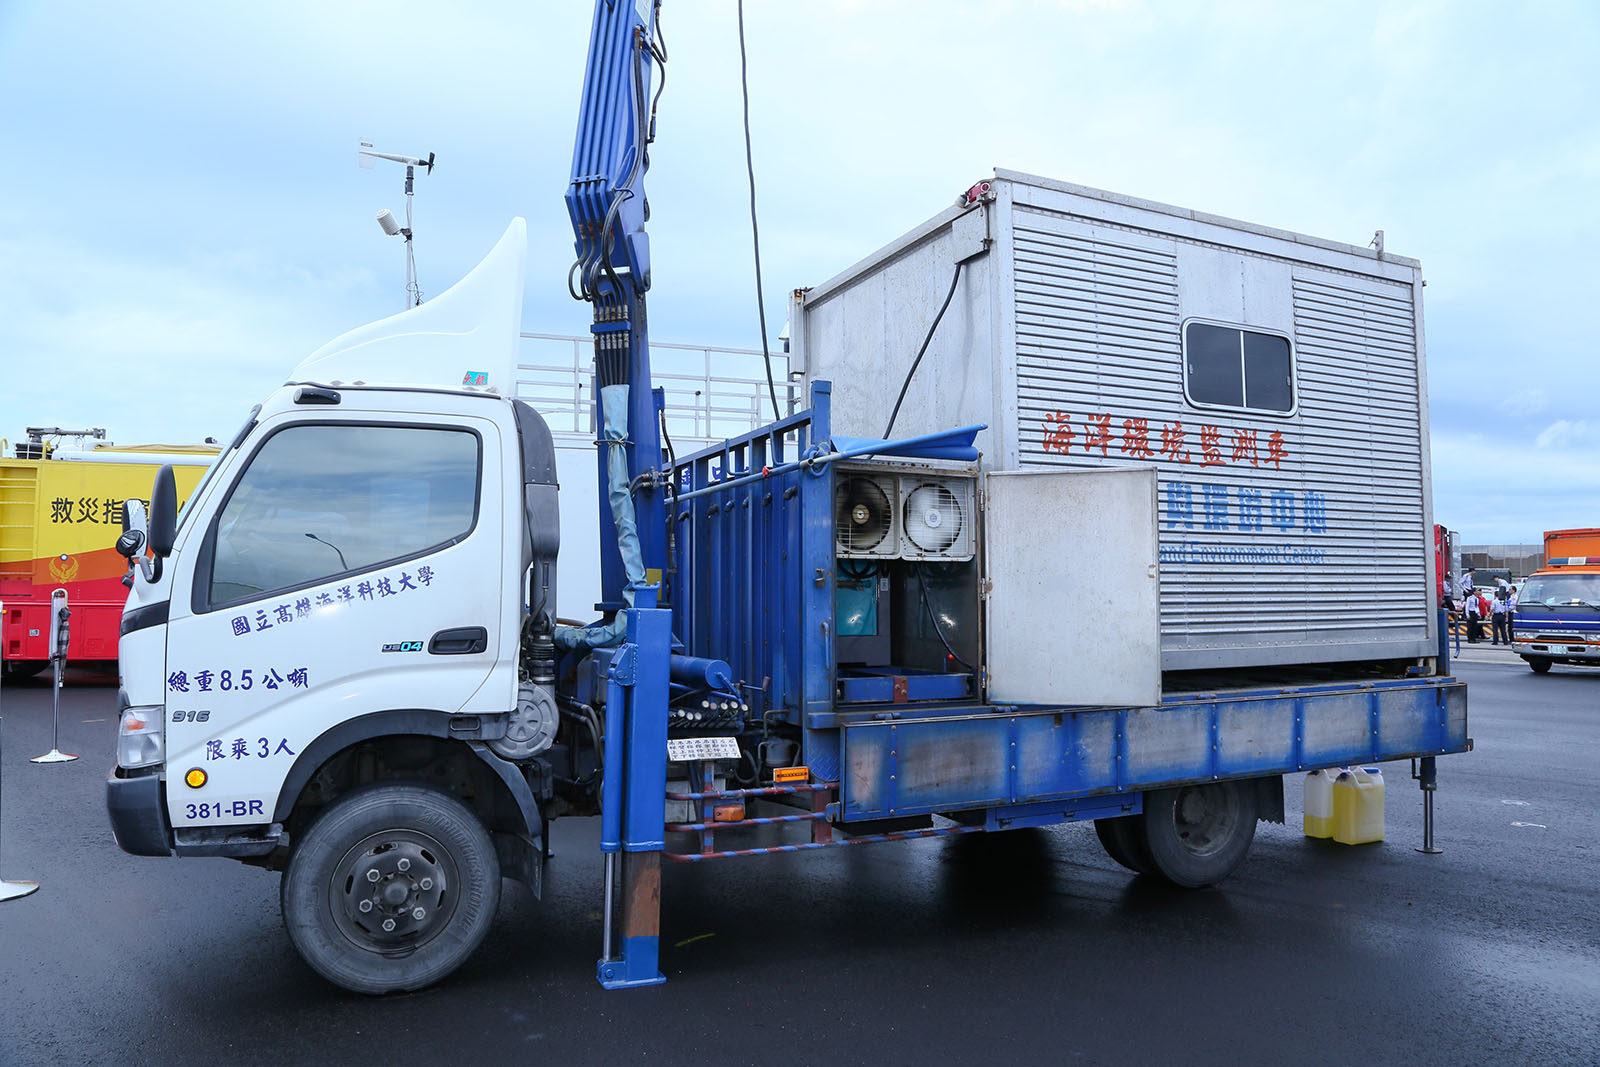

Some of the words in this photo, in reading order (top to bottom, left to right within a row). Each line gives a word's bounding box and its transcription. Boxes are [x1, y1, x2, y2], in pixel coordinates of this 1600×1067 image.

[1042, 410, 1288, 471] 海洋環境監測車
[1190, 540, 1280, 564] Environment
[1283, 543, 1326, 565] Center
[231, 566, 434, 636] 國立高雄海洋科技大學
[172, 710, 210, 722] 916
[206, 737, 296, 761] 限乘3人
[185, 800, 264, 819] 381-BR
